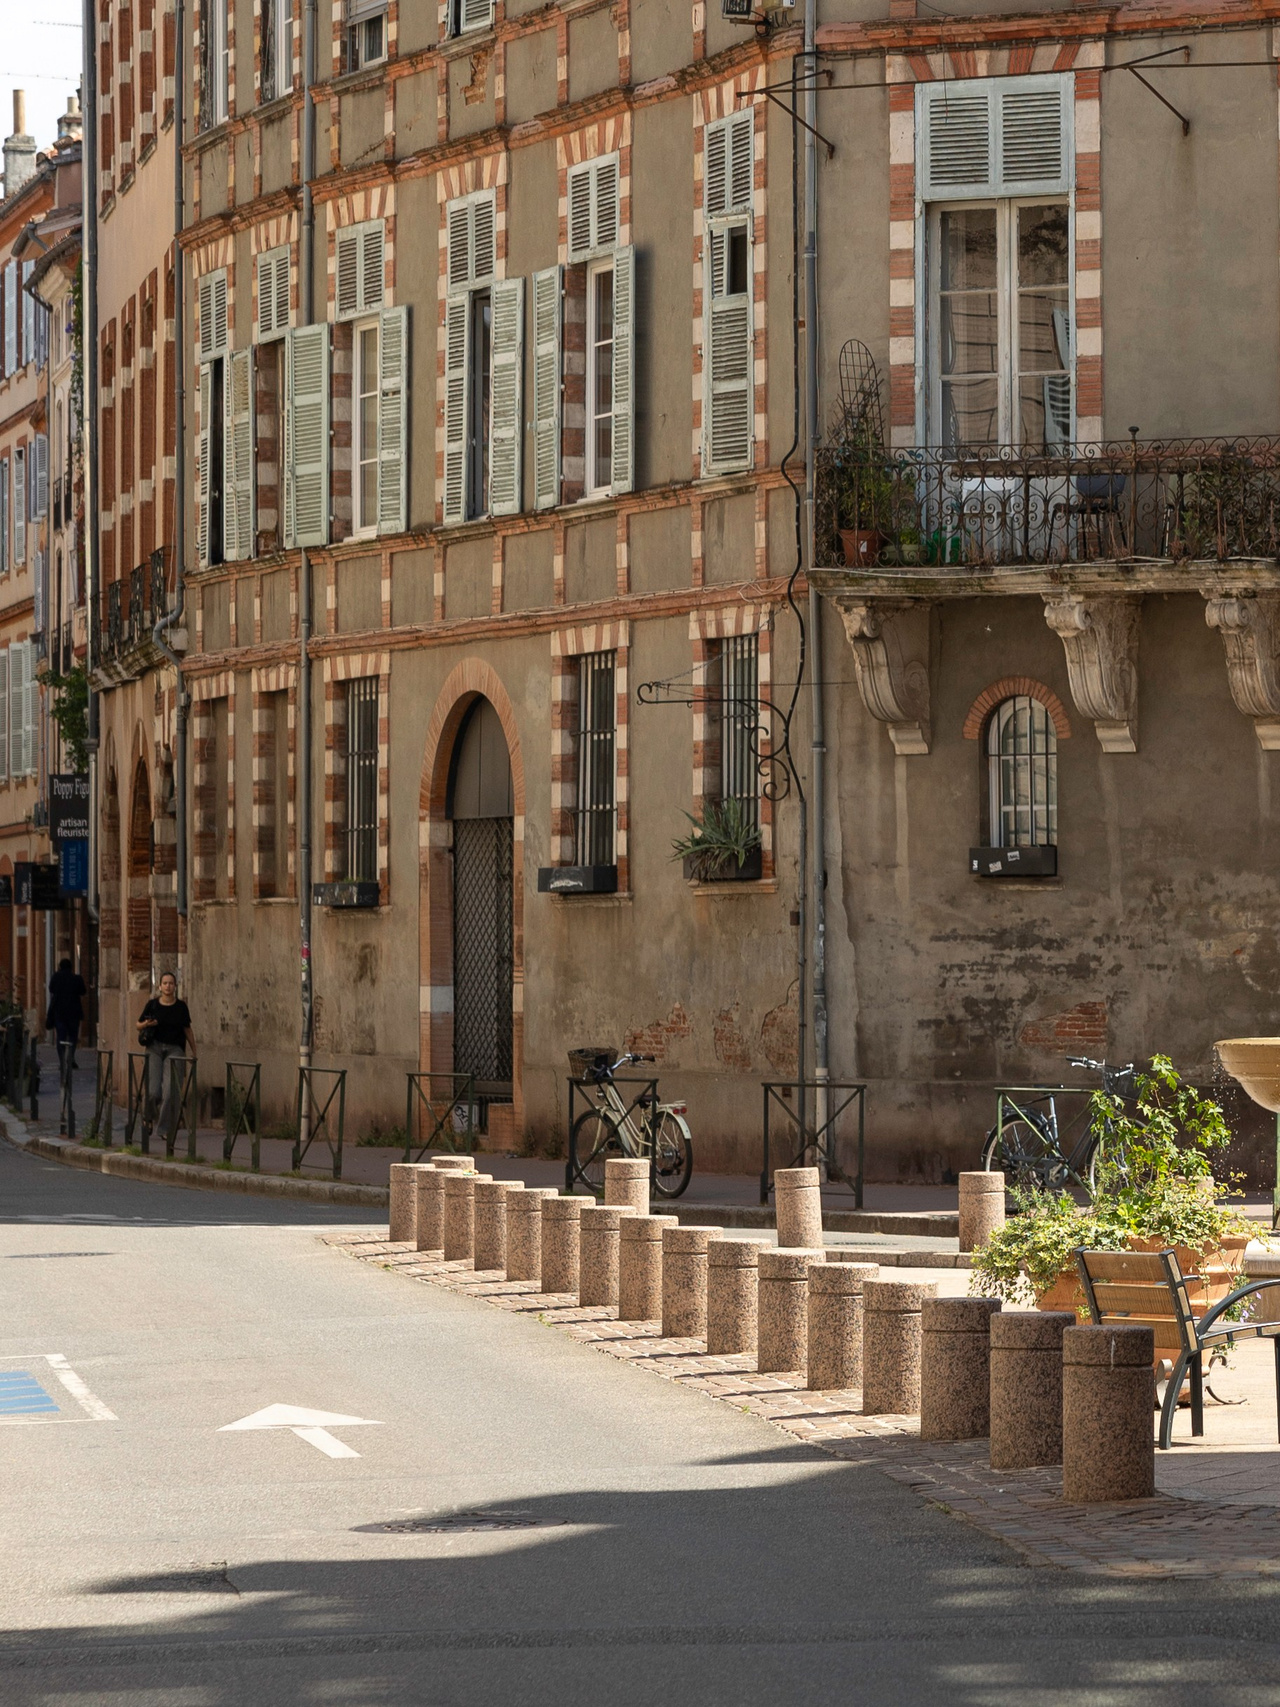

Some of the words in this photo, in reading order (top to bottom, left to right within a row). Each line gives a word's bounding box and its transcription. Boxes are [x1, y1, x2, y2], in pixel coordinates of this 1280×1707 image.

[53, 778, 73, 799] Poppy
[75, 778, 90, 799] Figu
[60, 818, 87, 828] artisan
